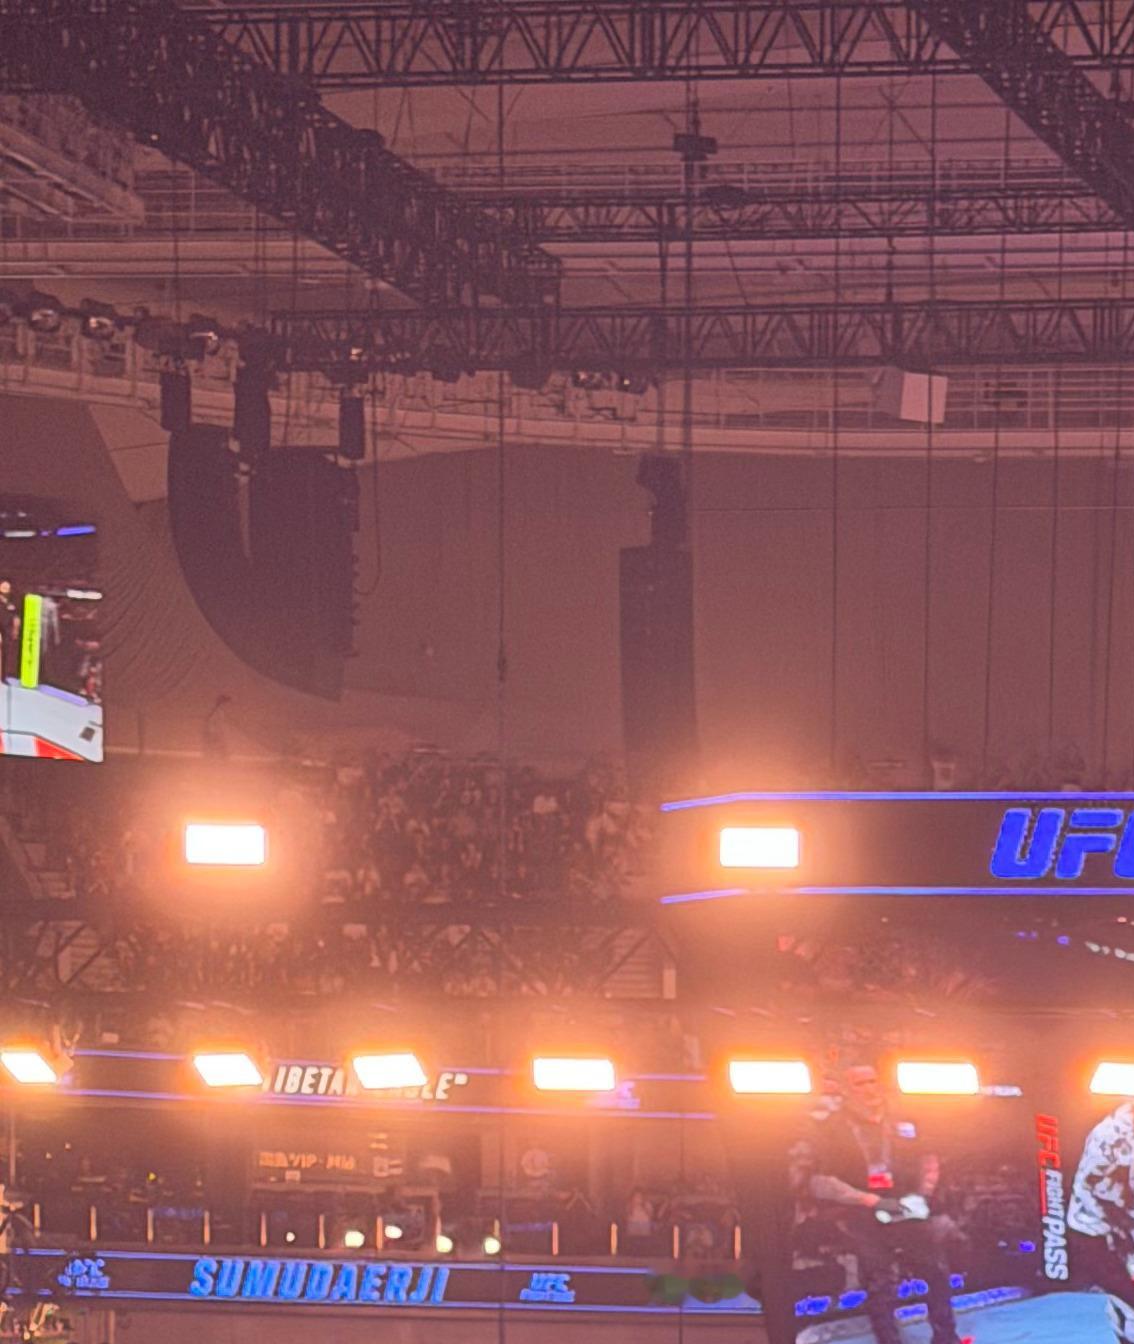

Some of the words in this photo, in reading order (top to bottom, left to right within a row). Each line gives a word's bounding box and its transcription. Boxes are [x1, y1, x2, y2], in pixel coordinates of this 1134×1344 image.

[1035, 1113, 1061, 1169] UFC
[1042, 1215, 1069, 1281] PASS
[190, 1257, 450, 1304] SUMUDAERJI
